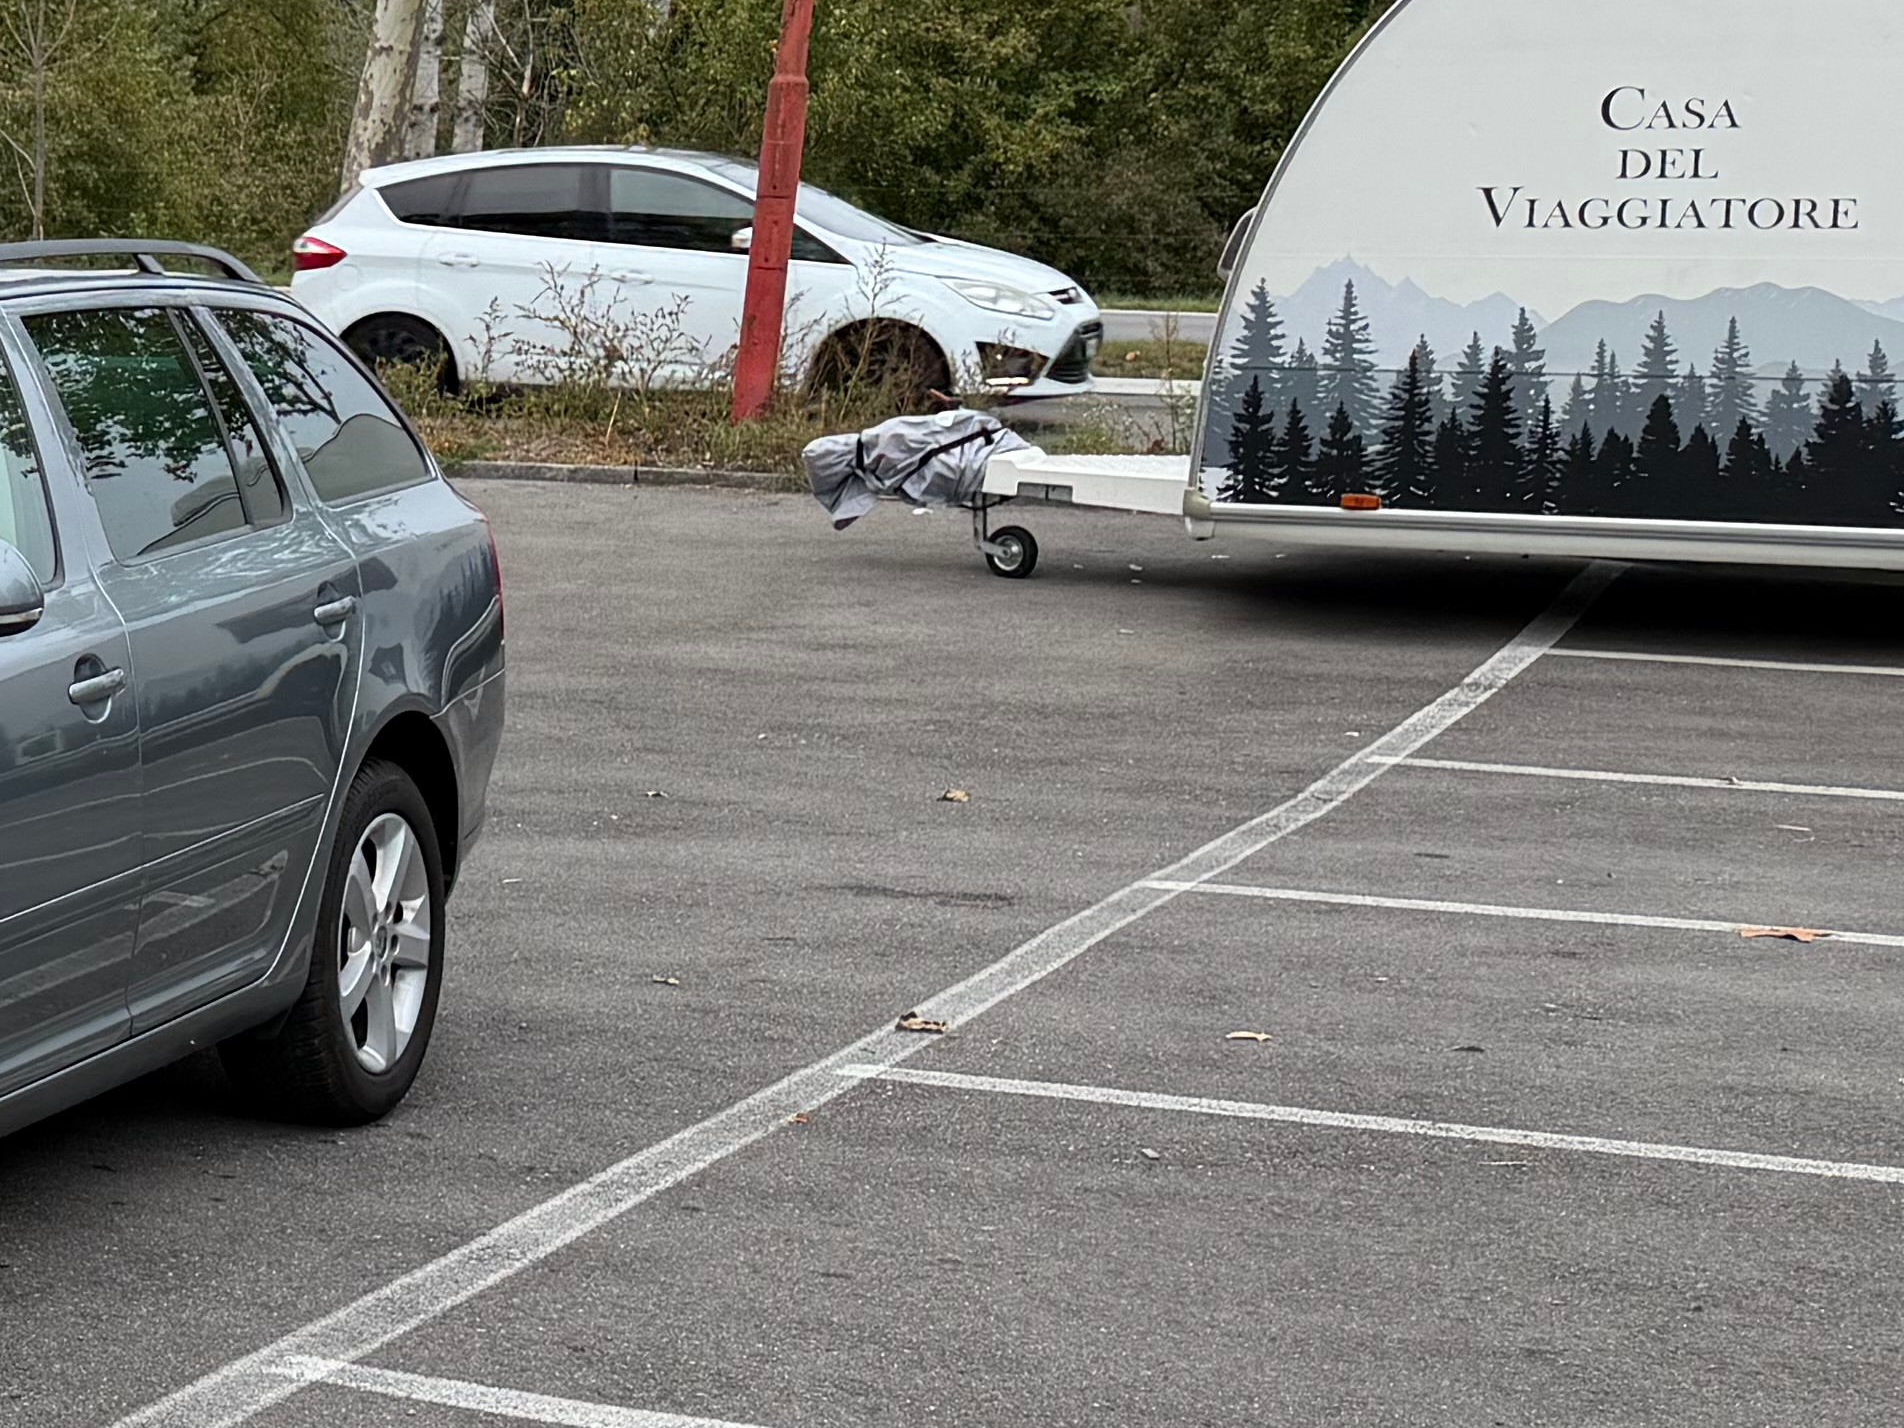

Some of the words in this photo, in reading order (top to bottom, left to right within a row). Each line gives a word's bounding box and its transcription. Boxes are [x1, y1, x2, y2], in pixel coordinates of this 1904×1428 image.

[1600, 86, 1741, 130] CASA
[1615, 148, 1718, 179] DEL
[1478, 186, 1859, 229] VIAGGIATORE
